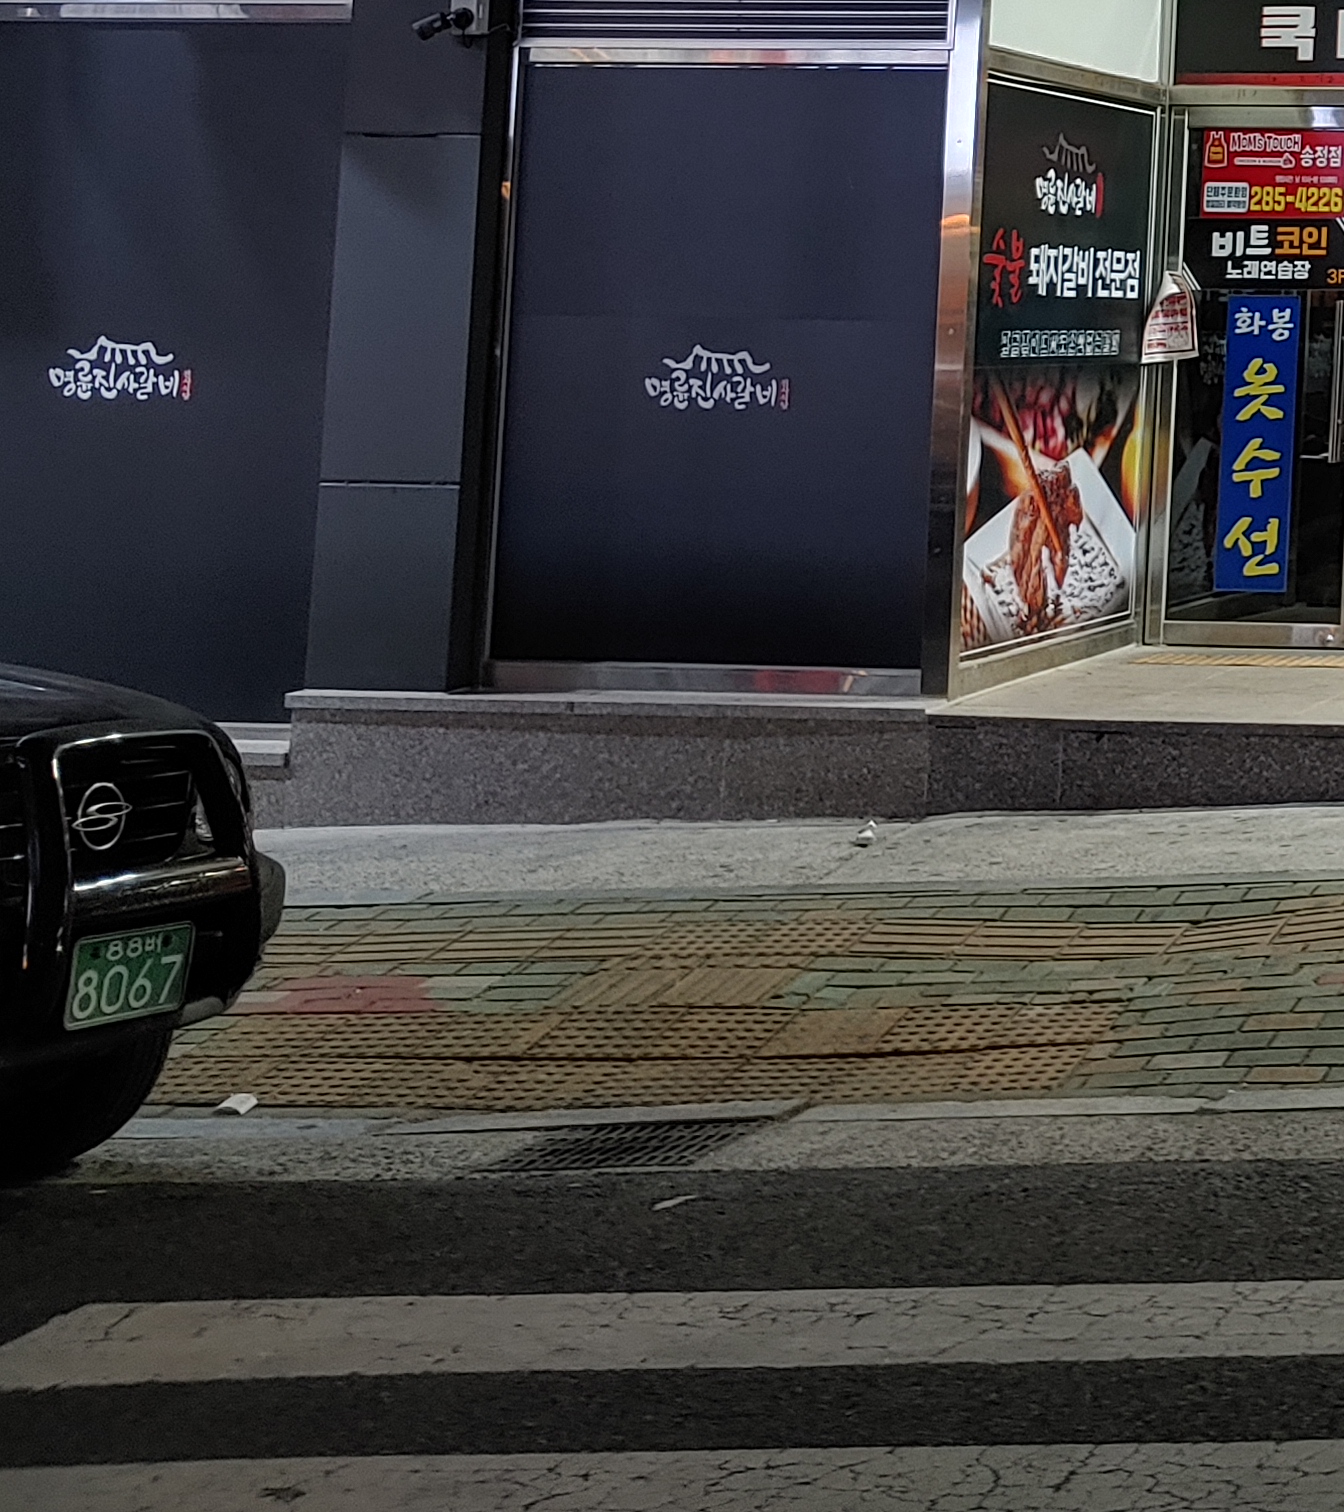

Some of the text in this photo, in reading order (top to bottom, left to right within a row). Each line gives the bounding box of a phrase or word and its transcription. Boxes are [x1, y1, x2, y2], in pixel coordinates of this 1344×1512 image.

[1260, 5, 1317, 61] 쿡
[1264, 133, 1301, 152] TOUCH
[1300, 144, 1342, 168] 송정점
[1249, 185, 1344, 213] 285-4226
[1211, 224, 1328, 257] 비트코인
[1225, 260, 1311, 280] 노래연습장
[1234, 307, 1295, 341] 화봉
[71, 954, 185, 1020] 8067
